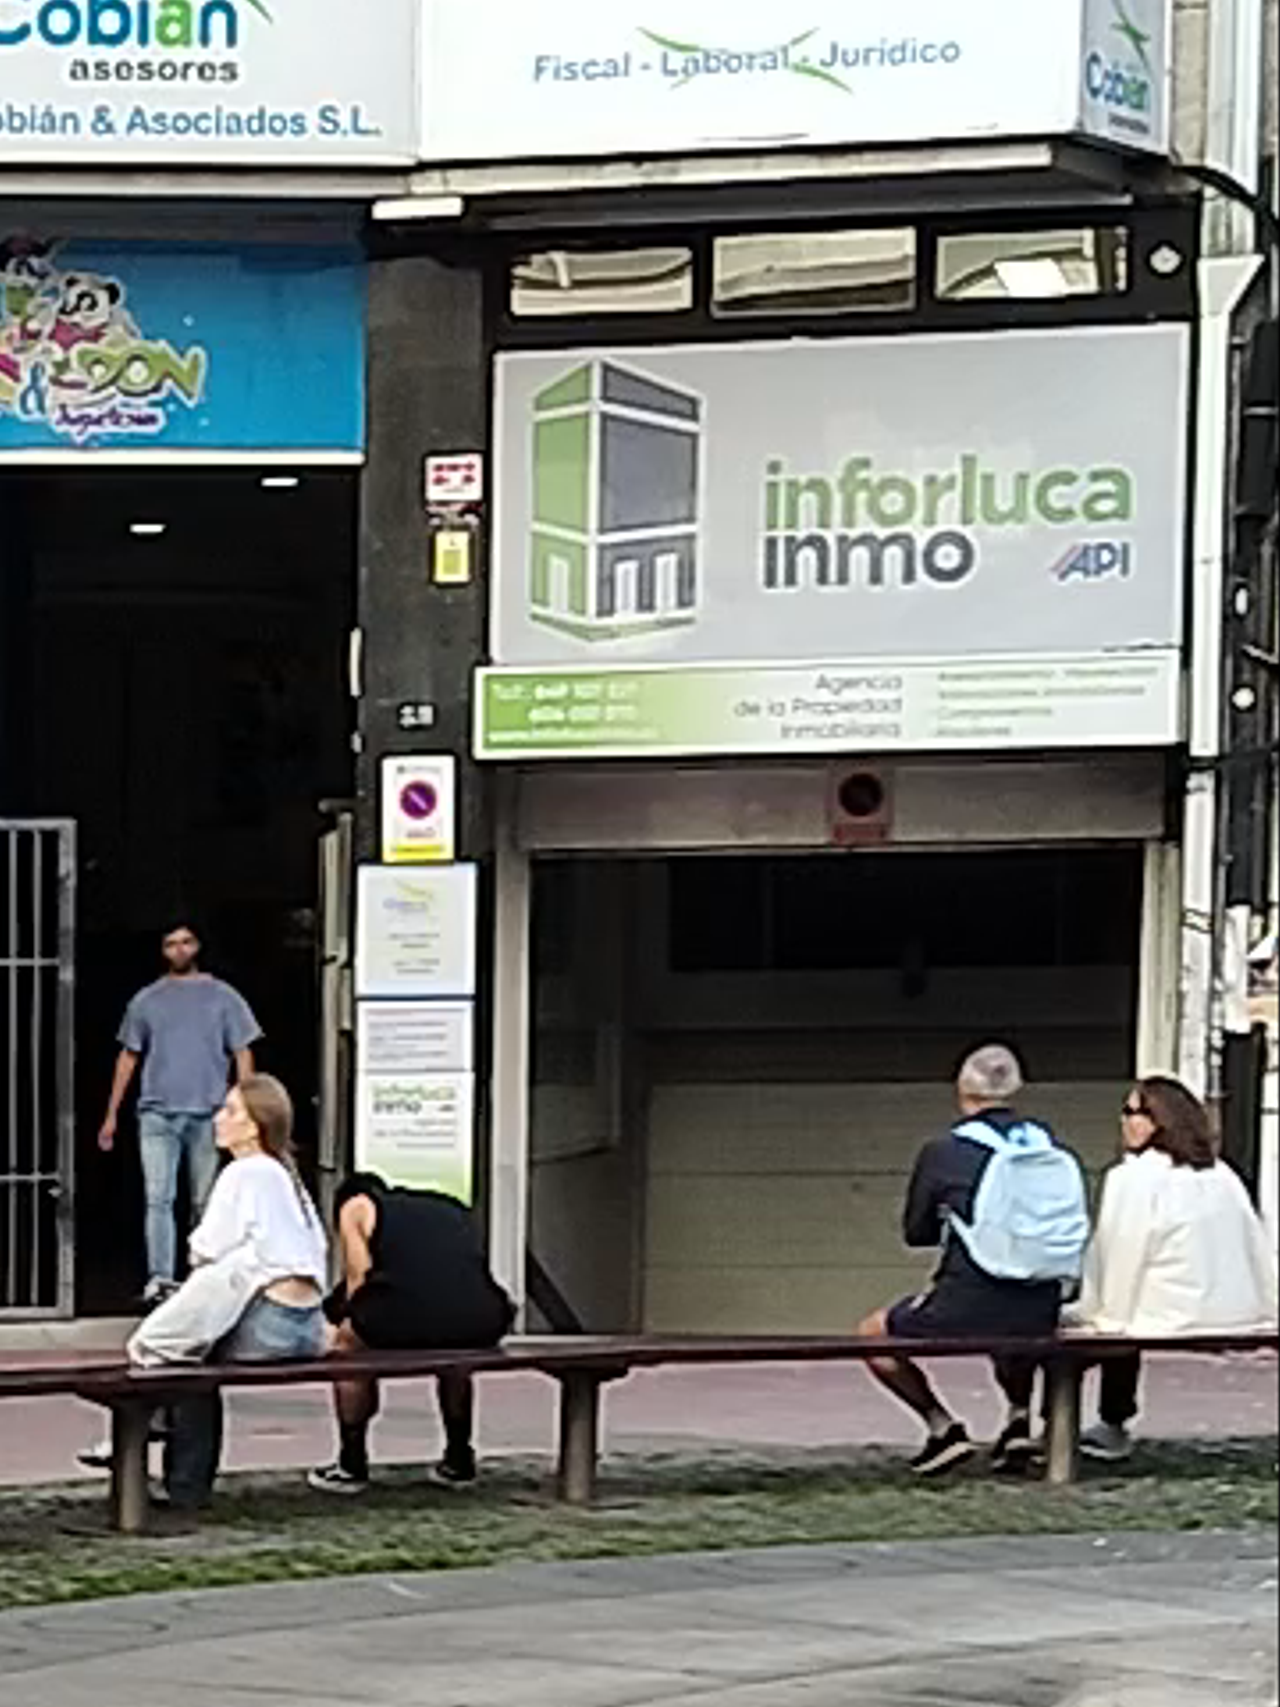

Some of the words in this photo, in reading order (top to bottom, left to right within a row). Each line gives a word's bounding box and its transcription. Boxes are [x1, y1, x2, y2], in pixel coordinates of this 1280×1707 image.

[70, 58, 238, 82] asesores
[534, 52, 630, 81] Fiscal
[661, 45, 789, 78] Laboral
[820, 38, 960, 69] Jurídico
[90, 107, 115, 134] &
[127, 106, 306, 135] Asociados
[318, 106, 381, 135] S.L.
[766, 455, 1131, 530] inforluca
[764, 531, 974, 587] inmo
[1051, 542, 1130, 581] API
[815, 674, 902, 695] Agencia
